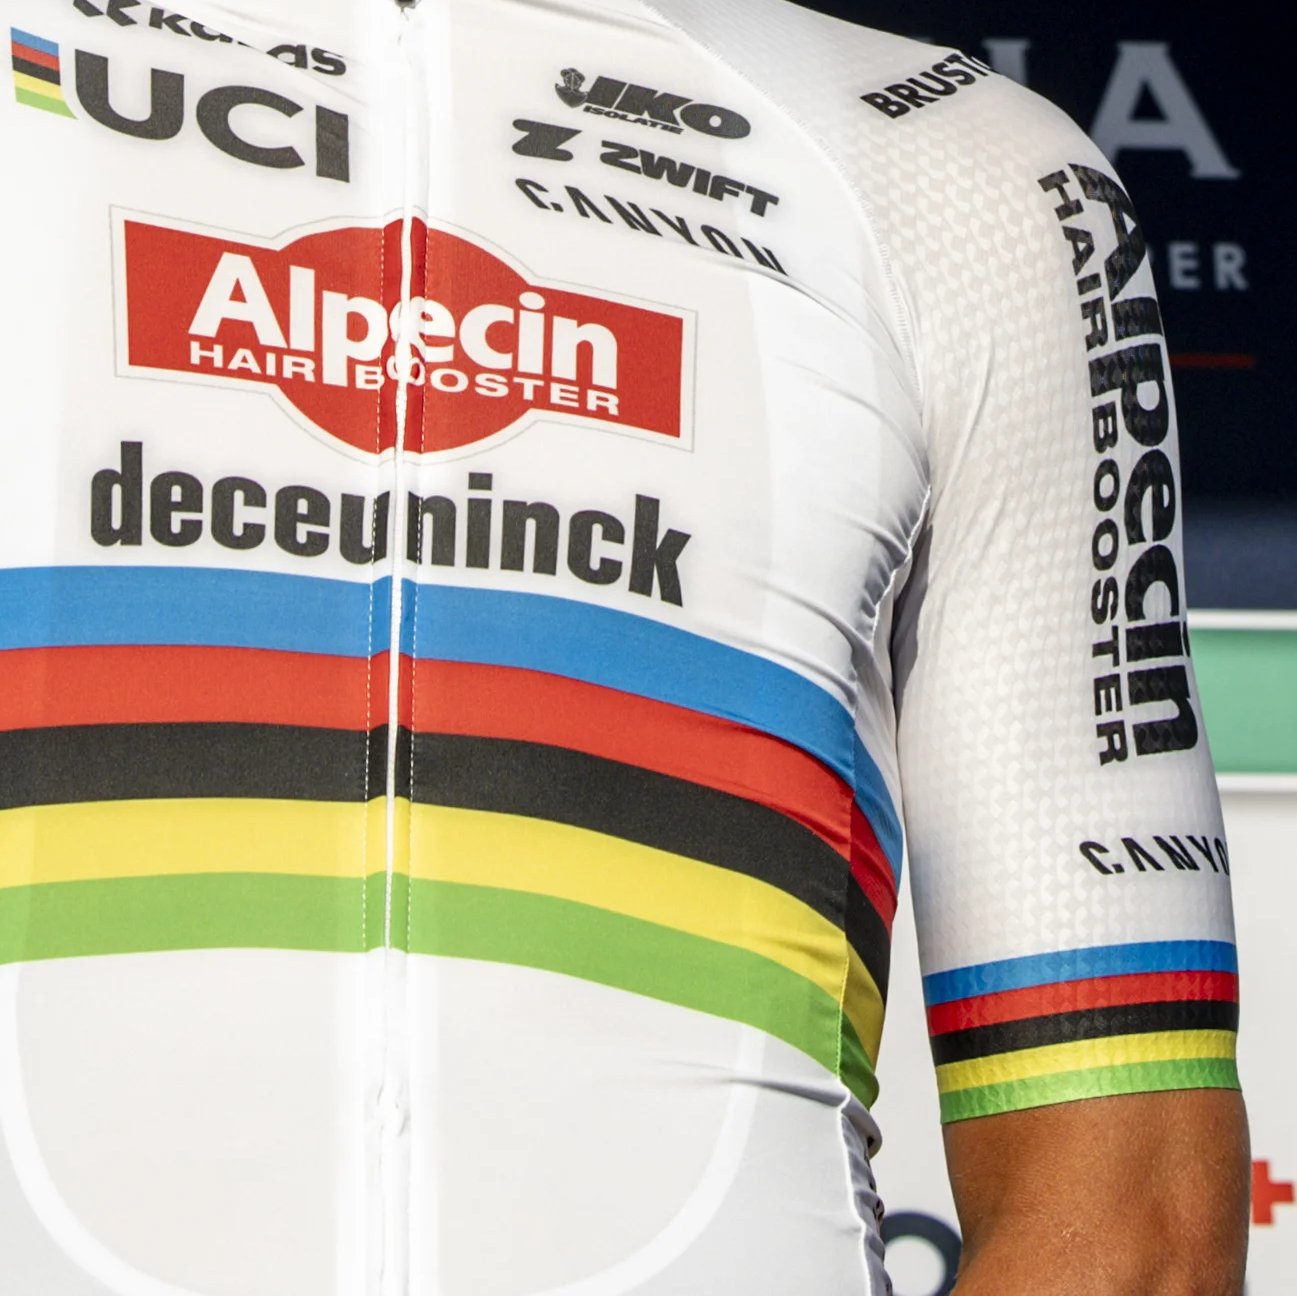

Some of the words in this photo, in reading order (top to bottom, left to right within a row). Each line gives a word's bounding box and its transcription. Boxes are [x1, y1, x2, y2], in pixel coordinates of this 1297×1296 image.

[75, 48, 350, 183] UCI
[582, 105, 684, 135] ISOLATIE
[586, 75, 751, 139] IKO
[599, 140, 779, 217] ZWIFT
[188, 251, 617, 390] Alpecin
[189, 341, 316, 383] HAIR
[355, 354, 620, 416] BOOSTER
[1037, 170, 1108, 352] HAIR
[1091, 401, 1128, 766] BOOSTER
[1068, 163, 1198, 756] Alpecin
[90, 441, 692, 607] deceuninck
[1079, 835, 1230, 876] CANYO
